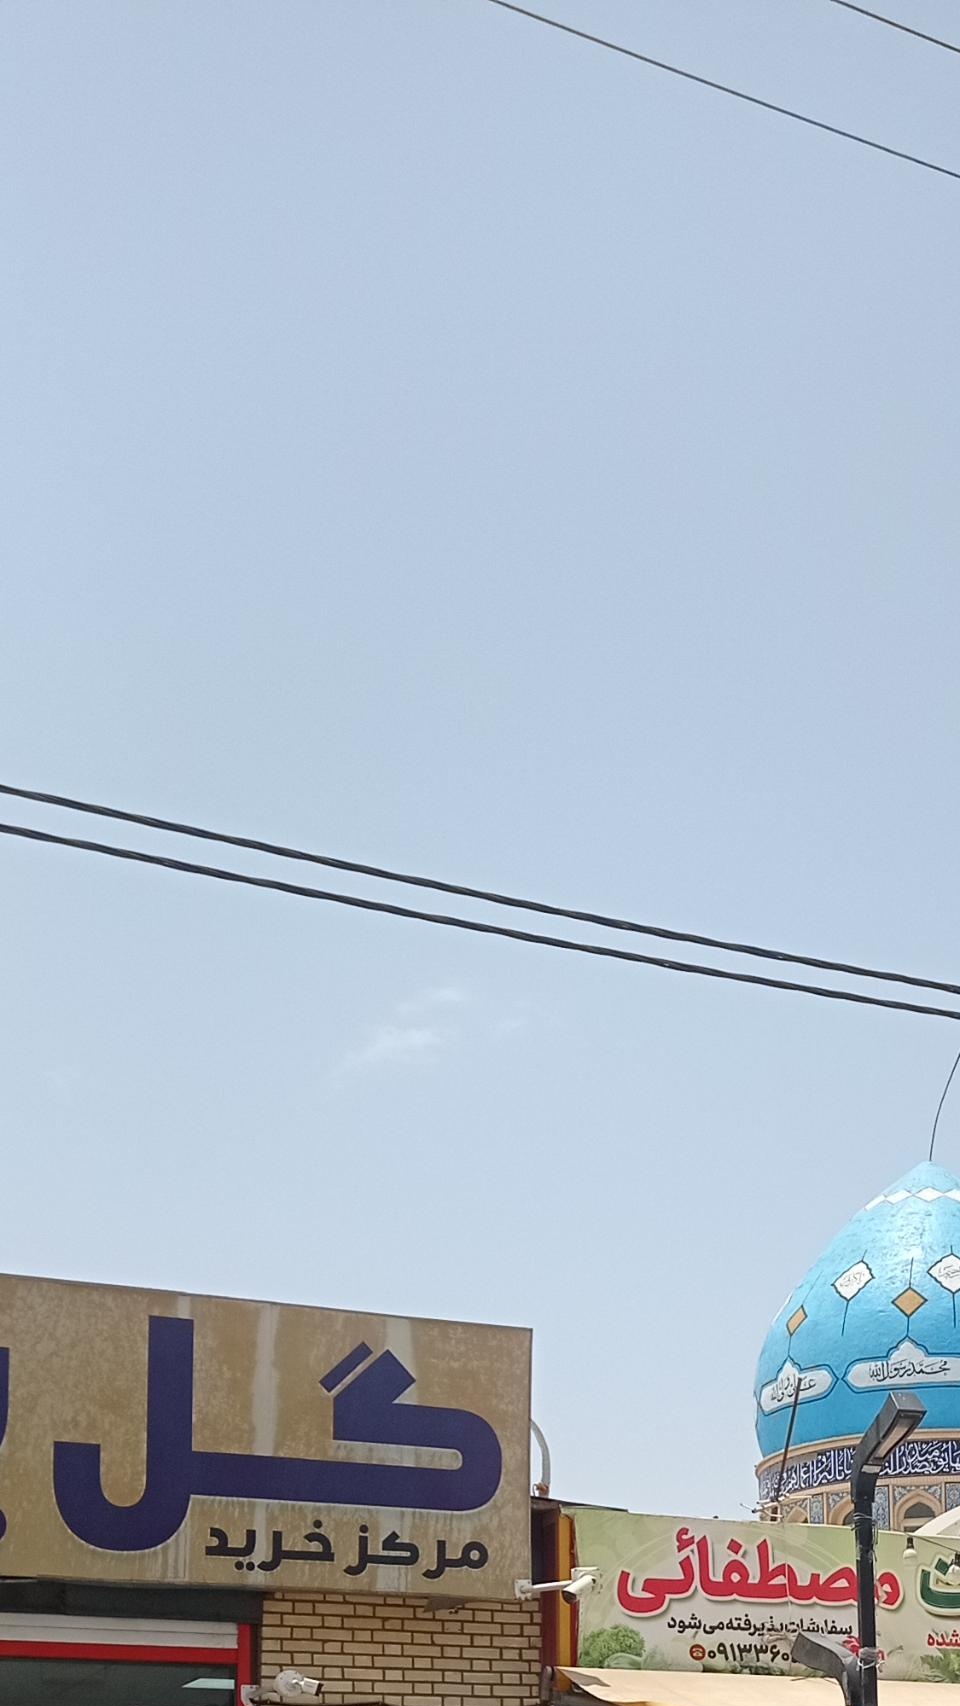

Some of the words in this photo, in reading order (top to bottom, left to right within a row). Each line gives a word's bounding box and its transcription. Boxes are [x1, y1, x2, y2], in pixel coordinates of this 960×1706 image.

[53, 1315, 502, 1551] گل
[205, 1519, 335, 1572] خرید
[343, 1523, 489, 1580] مرکز
[617, 1527, 902, 1615] مصطفائی
